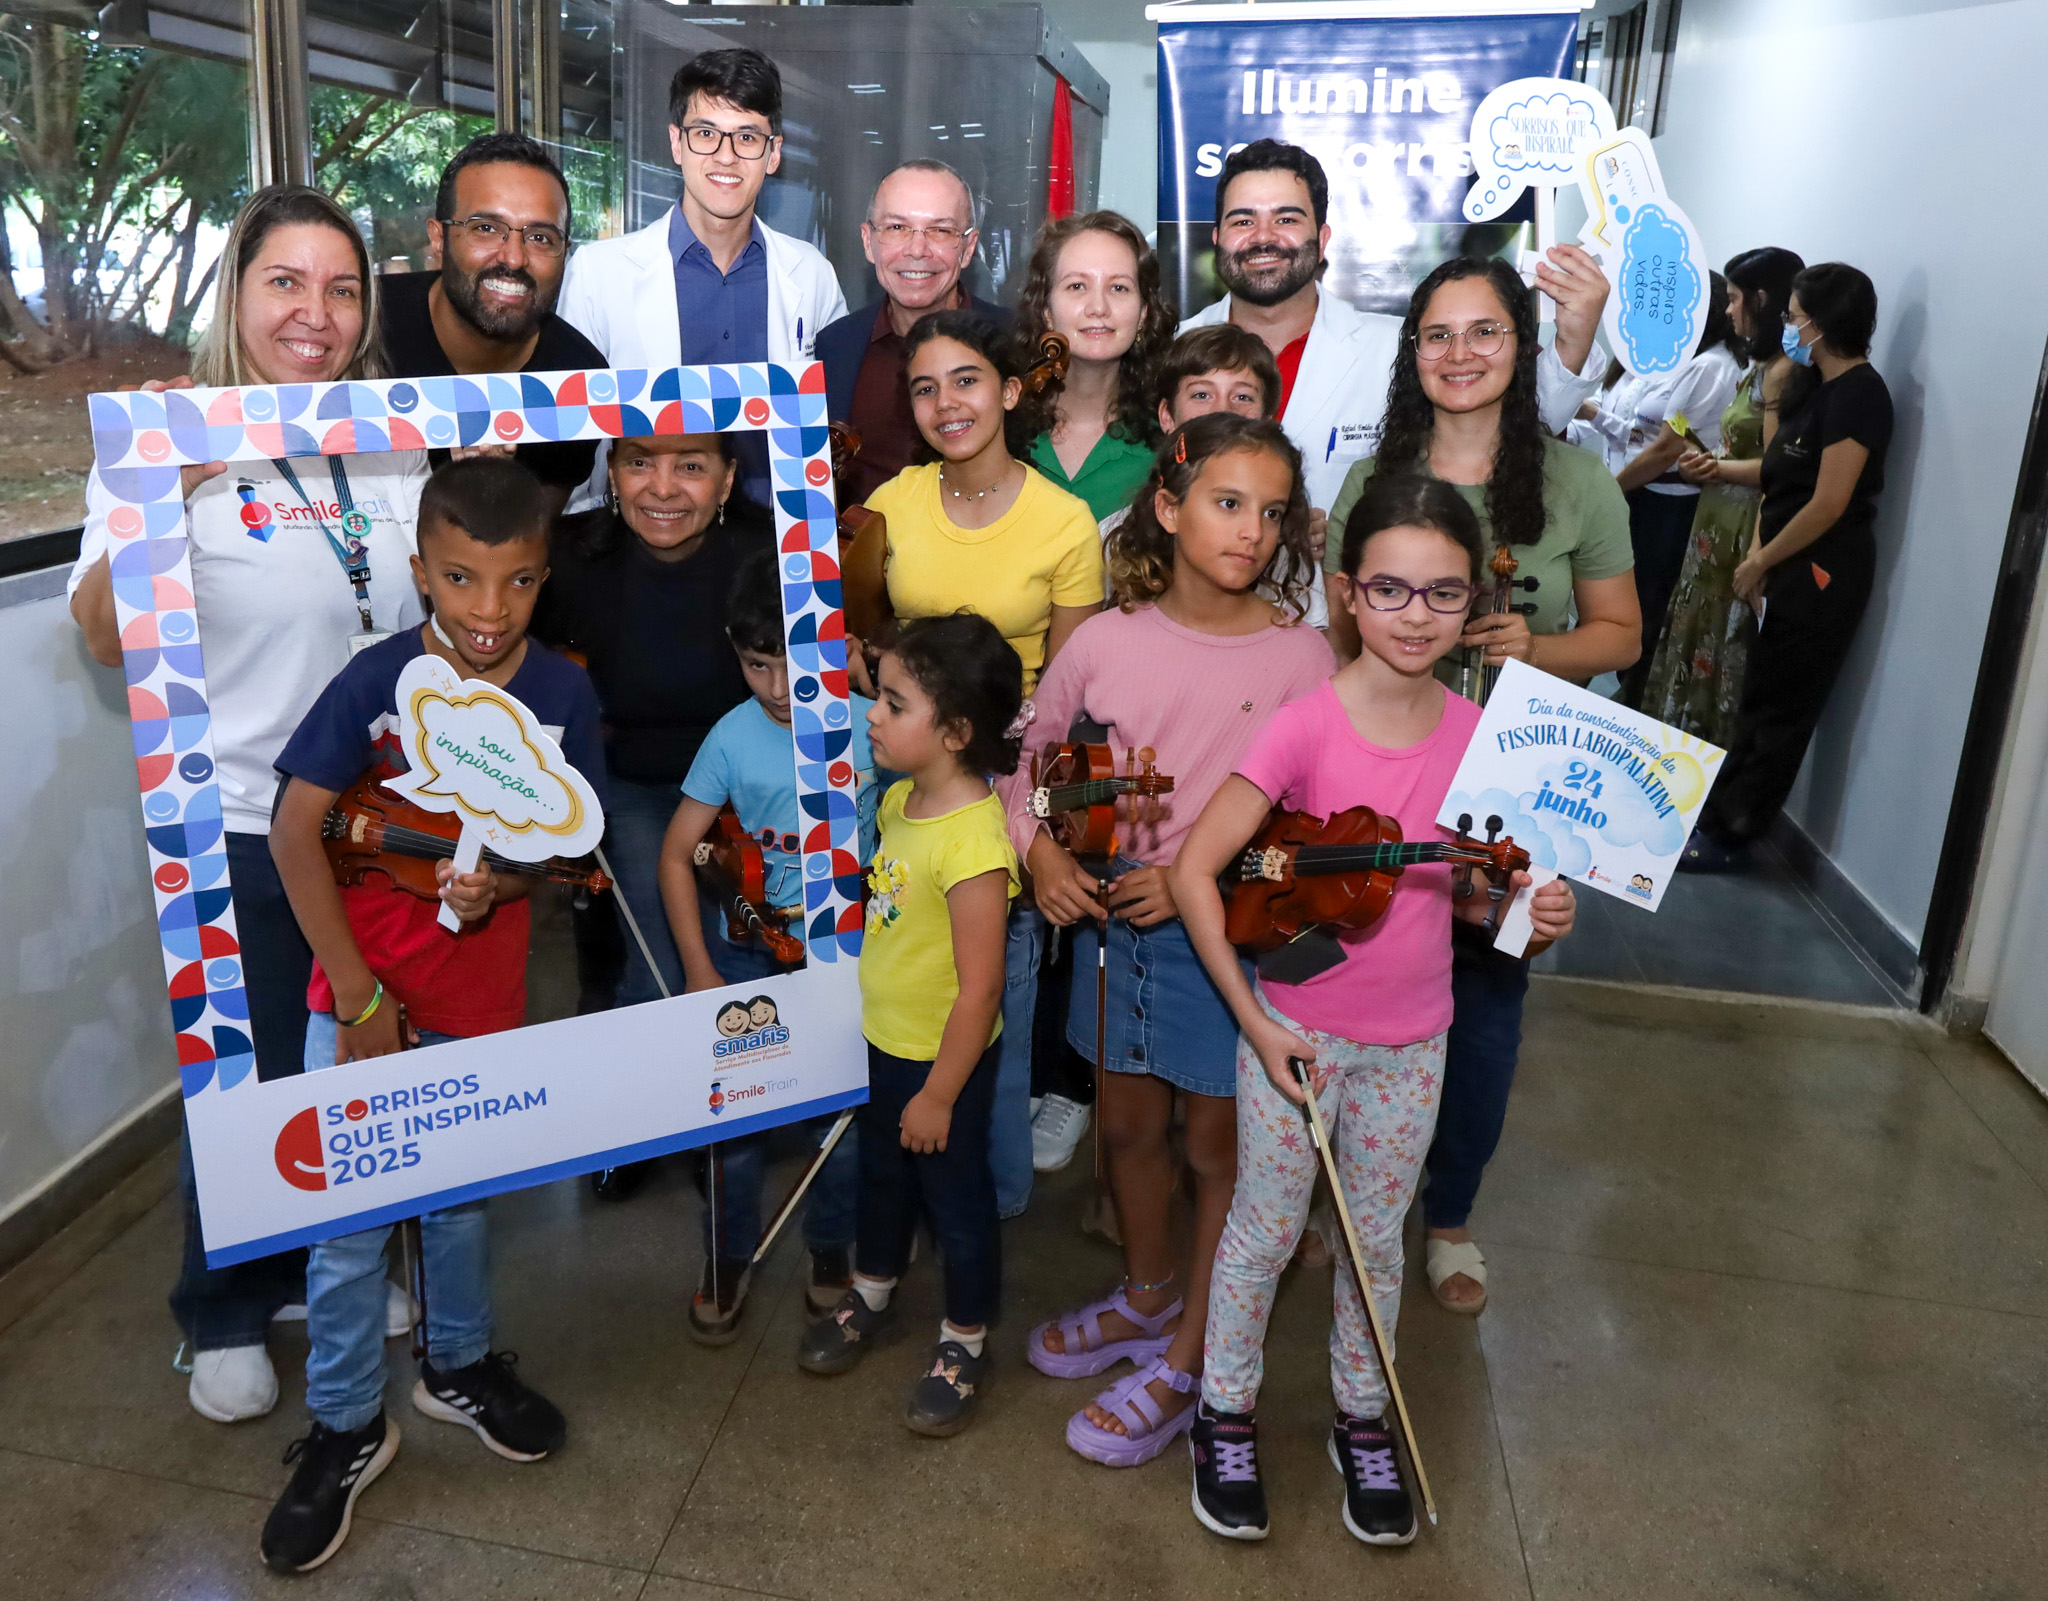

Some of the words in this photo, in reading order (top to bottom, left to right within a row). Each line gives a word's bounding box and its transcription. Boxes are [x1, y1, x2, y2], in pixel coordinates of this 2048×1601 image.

[1242, 67, 1462, 115] Ilumine
[1511, 117, 1559, 135] SORRISOS
[1566, 120, 1586, 137] QUE
[1649, 255, 1662, 319] outras
[1663, 261, 1678, 325] inspiro
[478, 736, 515, 763] sou
[1527, 698, 1554, 715] Dia
[1556, 703, 1573, 719] da
[1575, 710, 1662, 760] conscientização
[1660, 758, 1676, 775] da
[1496, 724, 1567, 753] FISSURA
[1572, 727, 1675, 819] LABIOPALATINA
[1563, 761, 1603, 799] 24
[1532, 780, 1607, 829] junho
[713, 1025, 790, 1058] smafis
[713, 1060, 750, 1072] Atendimento
[763, 1050, 792, 1061] Fissurados
[715, 1056, 736, 1066] Serviço
[737, 1046, 780, 1060] Multidisciplinar
[326, 1074, 480, 1126] SORRISOS
[328, 1121, 395, 1156] QUE
[404, 1087, 547, 1137] INSPIRAM
[330, 1142, 421, 1186] 2025
